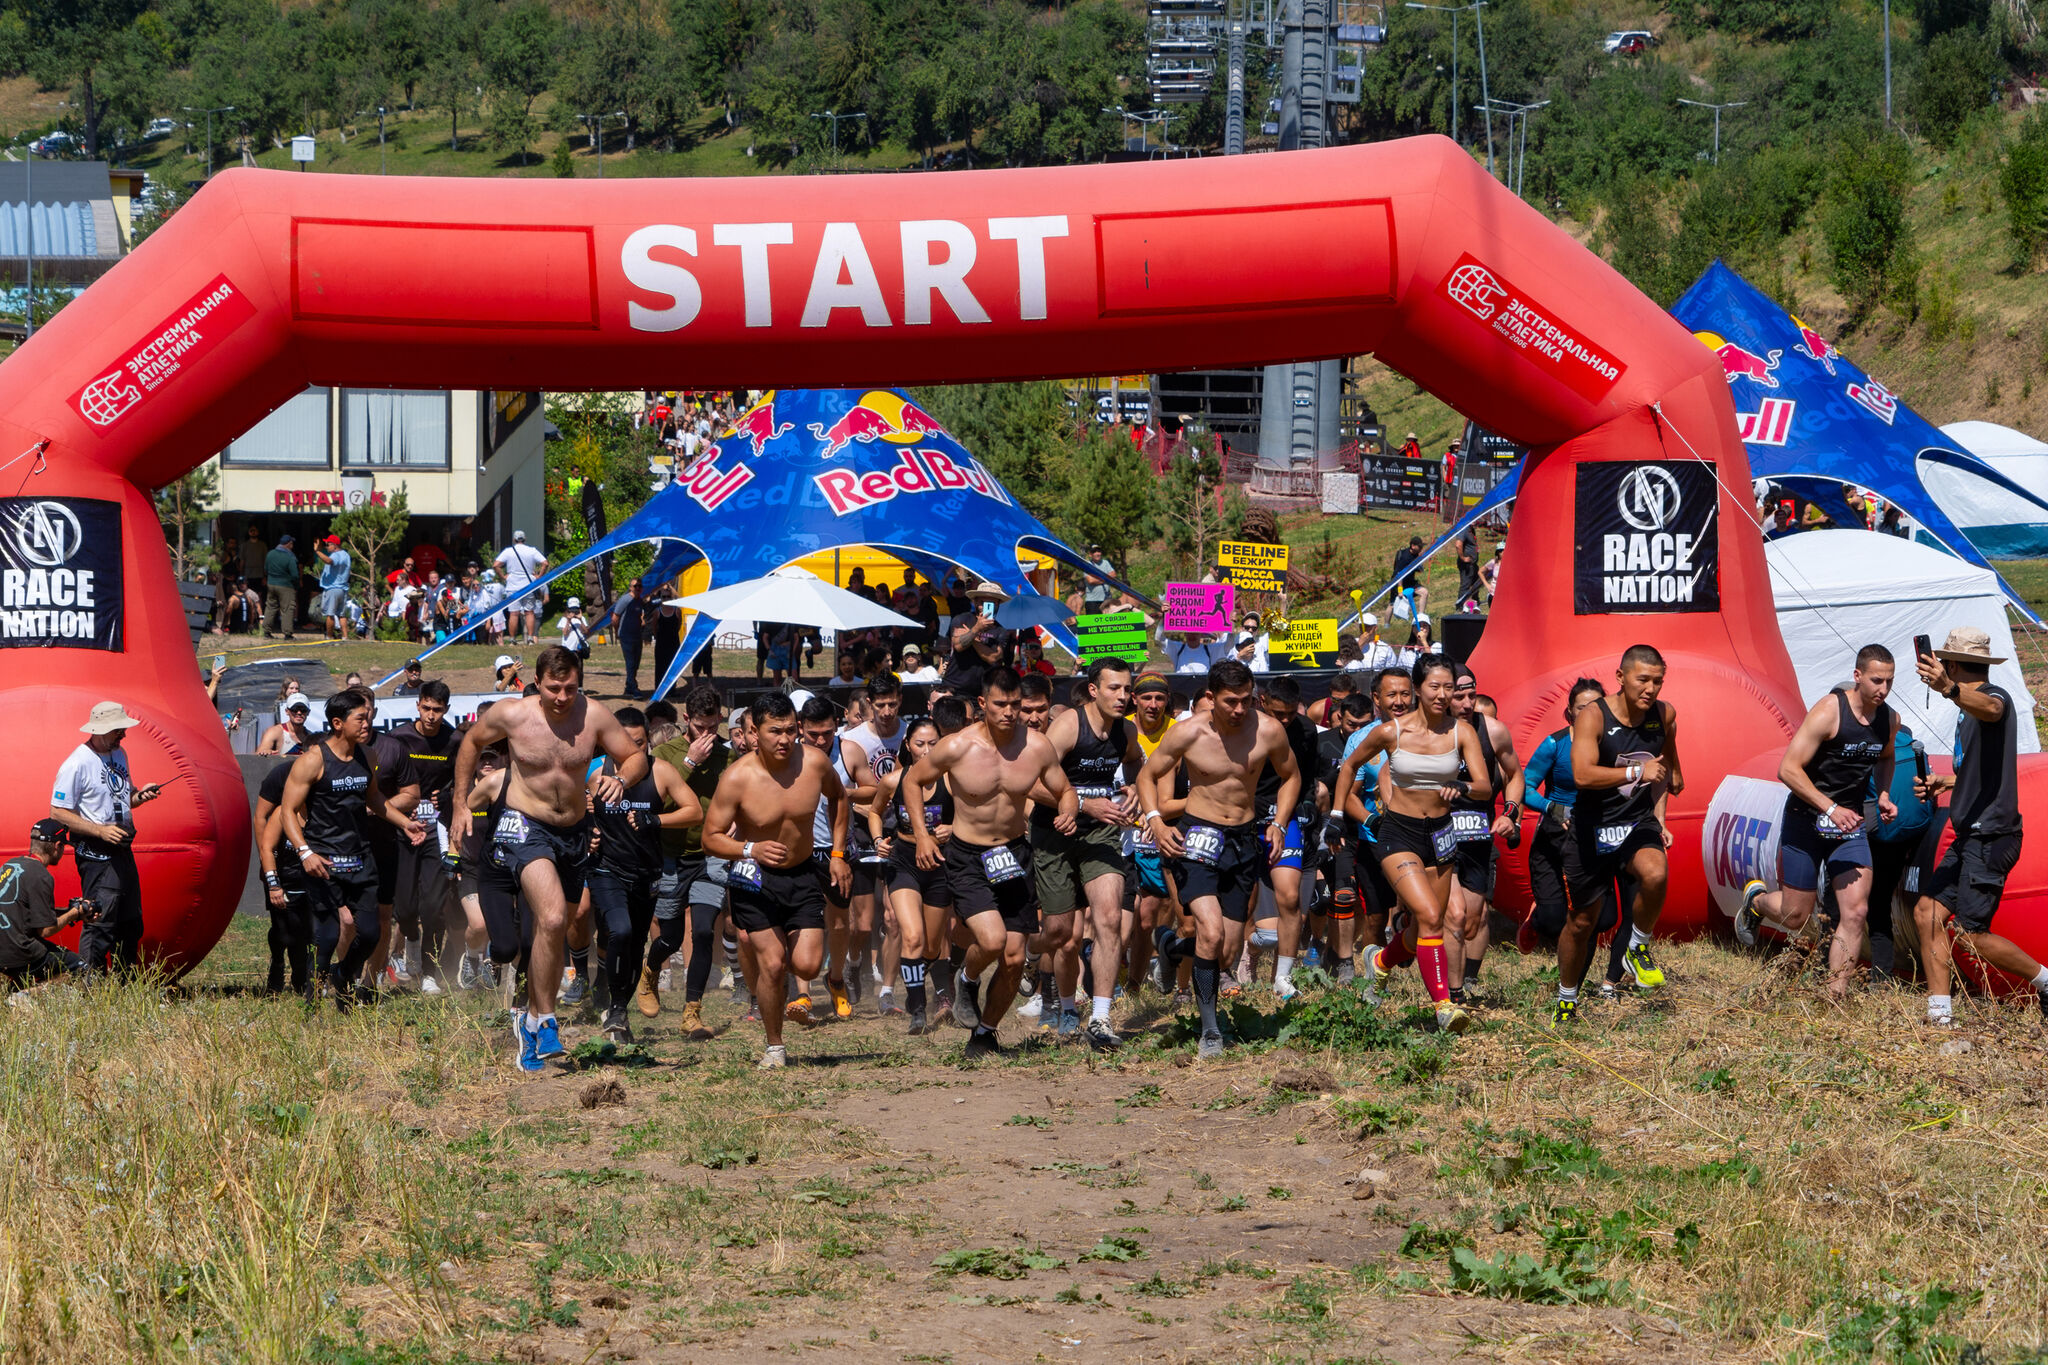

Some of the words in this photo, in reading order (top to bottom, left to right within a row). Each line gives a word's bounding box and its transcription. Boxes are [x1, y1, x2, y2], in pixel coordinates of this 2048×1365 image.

[621, 215, 1068, 332] START
[126, 283, 233, 374] ЭКСТРЕМАЛЬНАЯ
[1497, 311, 1564, 363] АТЛЕТИКА
[1507, 298, 1619, 381] ЭКСТРЕМАЛЬНАЯ
[1509, 333, 1528, 349] 2006
[137, 330, 203, 386] АТЛЕТИКА
[164, 361, 181, 378] 2006
[1734, 397, 1796, 446] ull
[815, 448, 935, 516] Red
[917, 449, 1012, 507] Bull
[1221, 544, 1286, 558] BEELINE
[1603, 533, 1692, 572] RACE
[1232, 556, 1273, 567] БЕЖИТ
[1230, 568, 1275, 579] ТРАССА
[3, 568, 95, 607] RACE
[1170, 587, 1205, 596] ФИНИШ
[1604, 575, 1693, 603] NATION
[1169, 608, 1187, 616] КАК
[1190, 608, 1196, 616] И
[1170, 598, 1205, 608] РЯДОМ!
[2, 610, 95, 638] NATION
[1099, 624, 1135, 632] УБЕЖИШЬ
[1169, 618, 1207, 627] BEELINE!
[1287, 623, 1319, 631] BEELINE
[410, 753, 447, 761] PARIMATCH
[417, 803, 433, 815] 018
[498, 817, 523, 833] 3012
[1186, 832, 1219, 853] 3012
[733, 860, 756, 880] 012
[986, 852, 1016, 873] 3012
